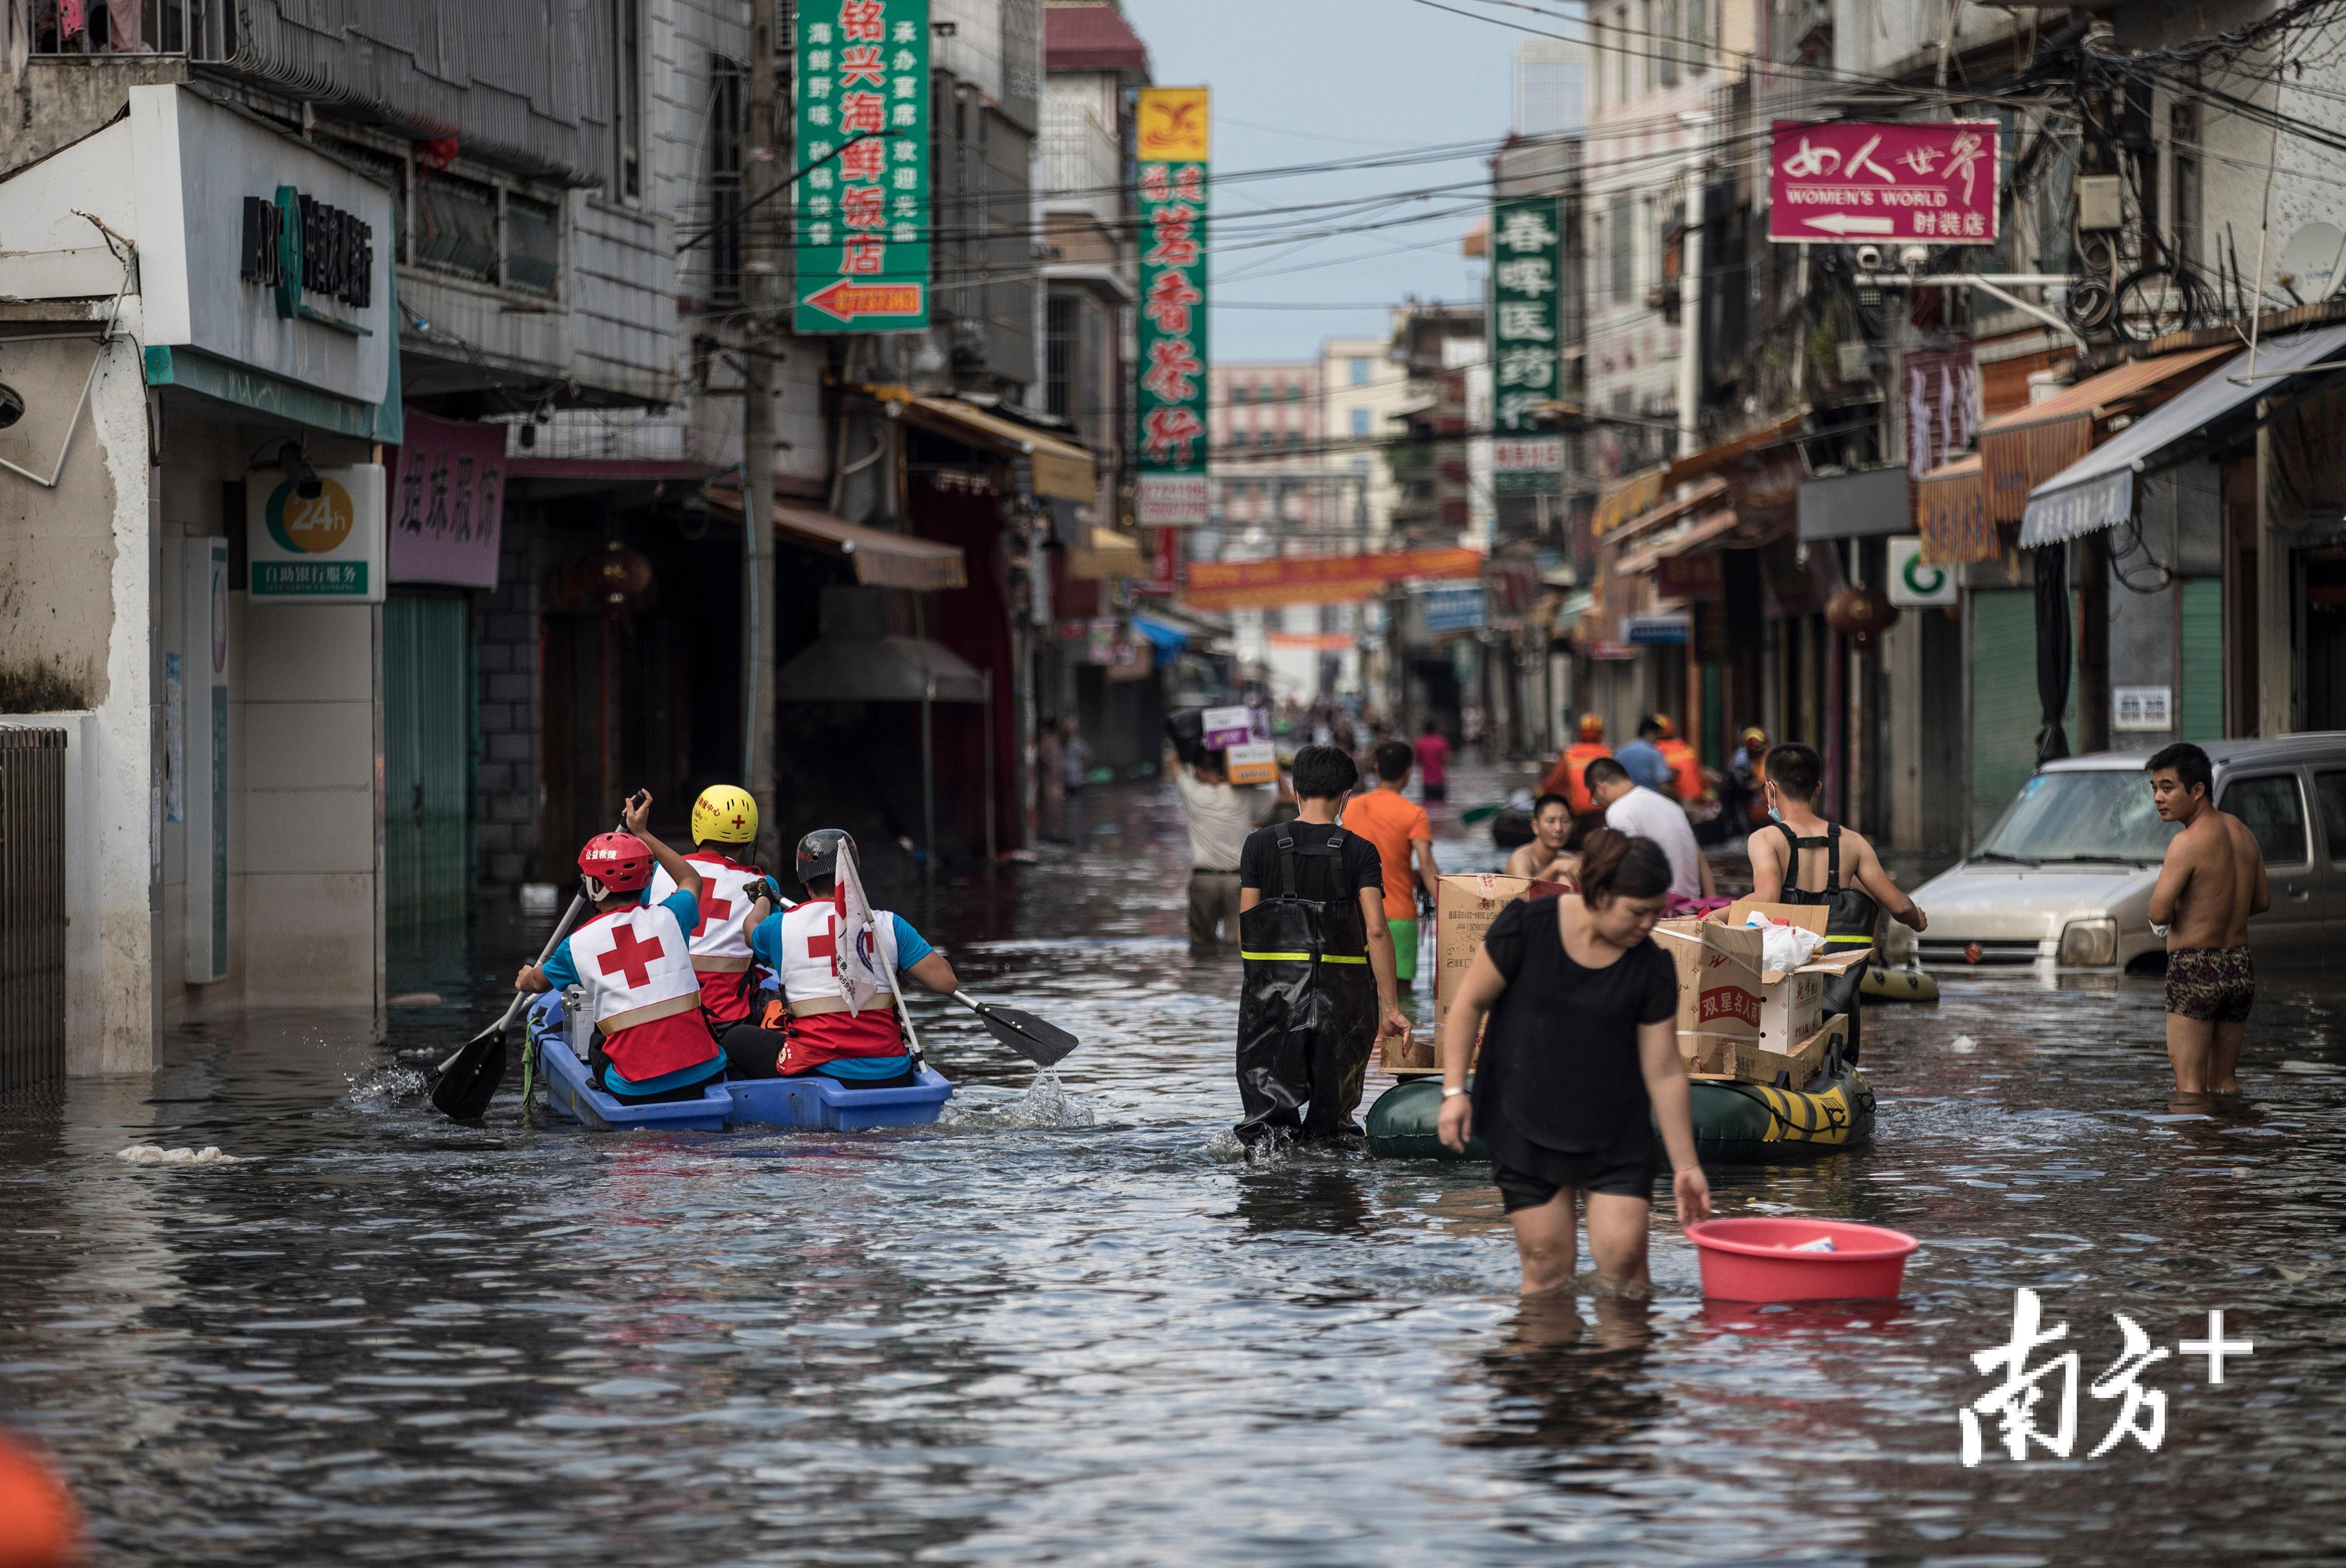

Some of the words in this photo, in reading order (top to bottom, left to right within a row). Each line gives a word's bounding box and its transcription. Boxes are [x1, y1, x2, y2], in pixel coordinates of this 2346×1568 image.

[838, 0, 889, 275] 铭兴海鲜饭店
[1781, 127, 1988, 206] 女人世界
[1786, 188, 1875, 206] WOMEN'S
[1880, 190, 1948, 207] WORLD
[1913, 211, 1985, 236] 时装店
[266, 565, 357, 583] 自助银行服务
[586, 849, 618, 860] 公益救援
[1702, 991, 1761, 1023] 双星名人雨
[1795, 1023, 1809, 1038] PEAK
